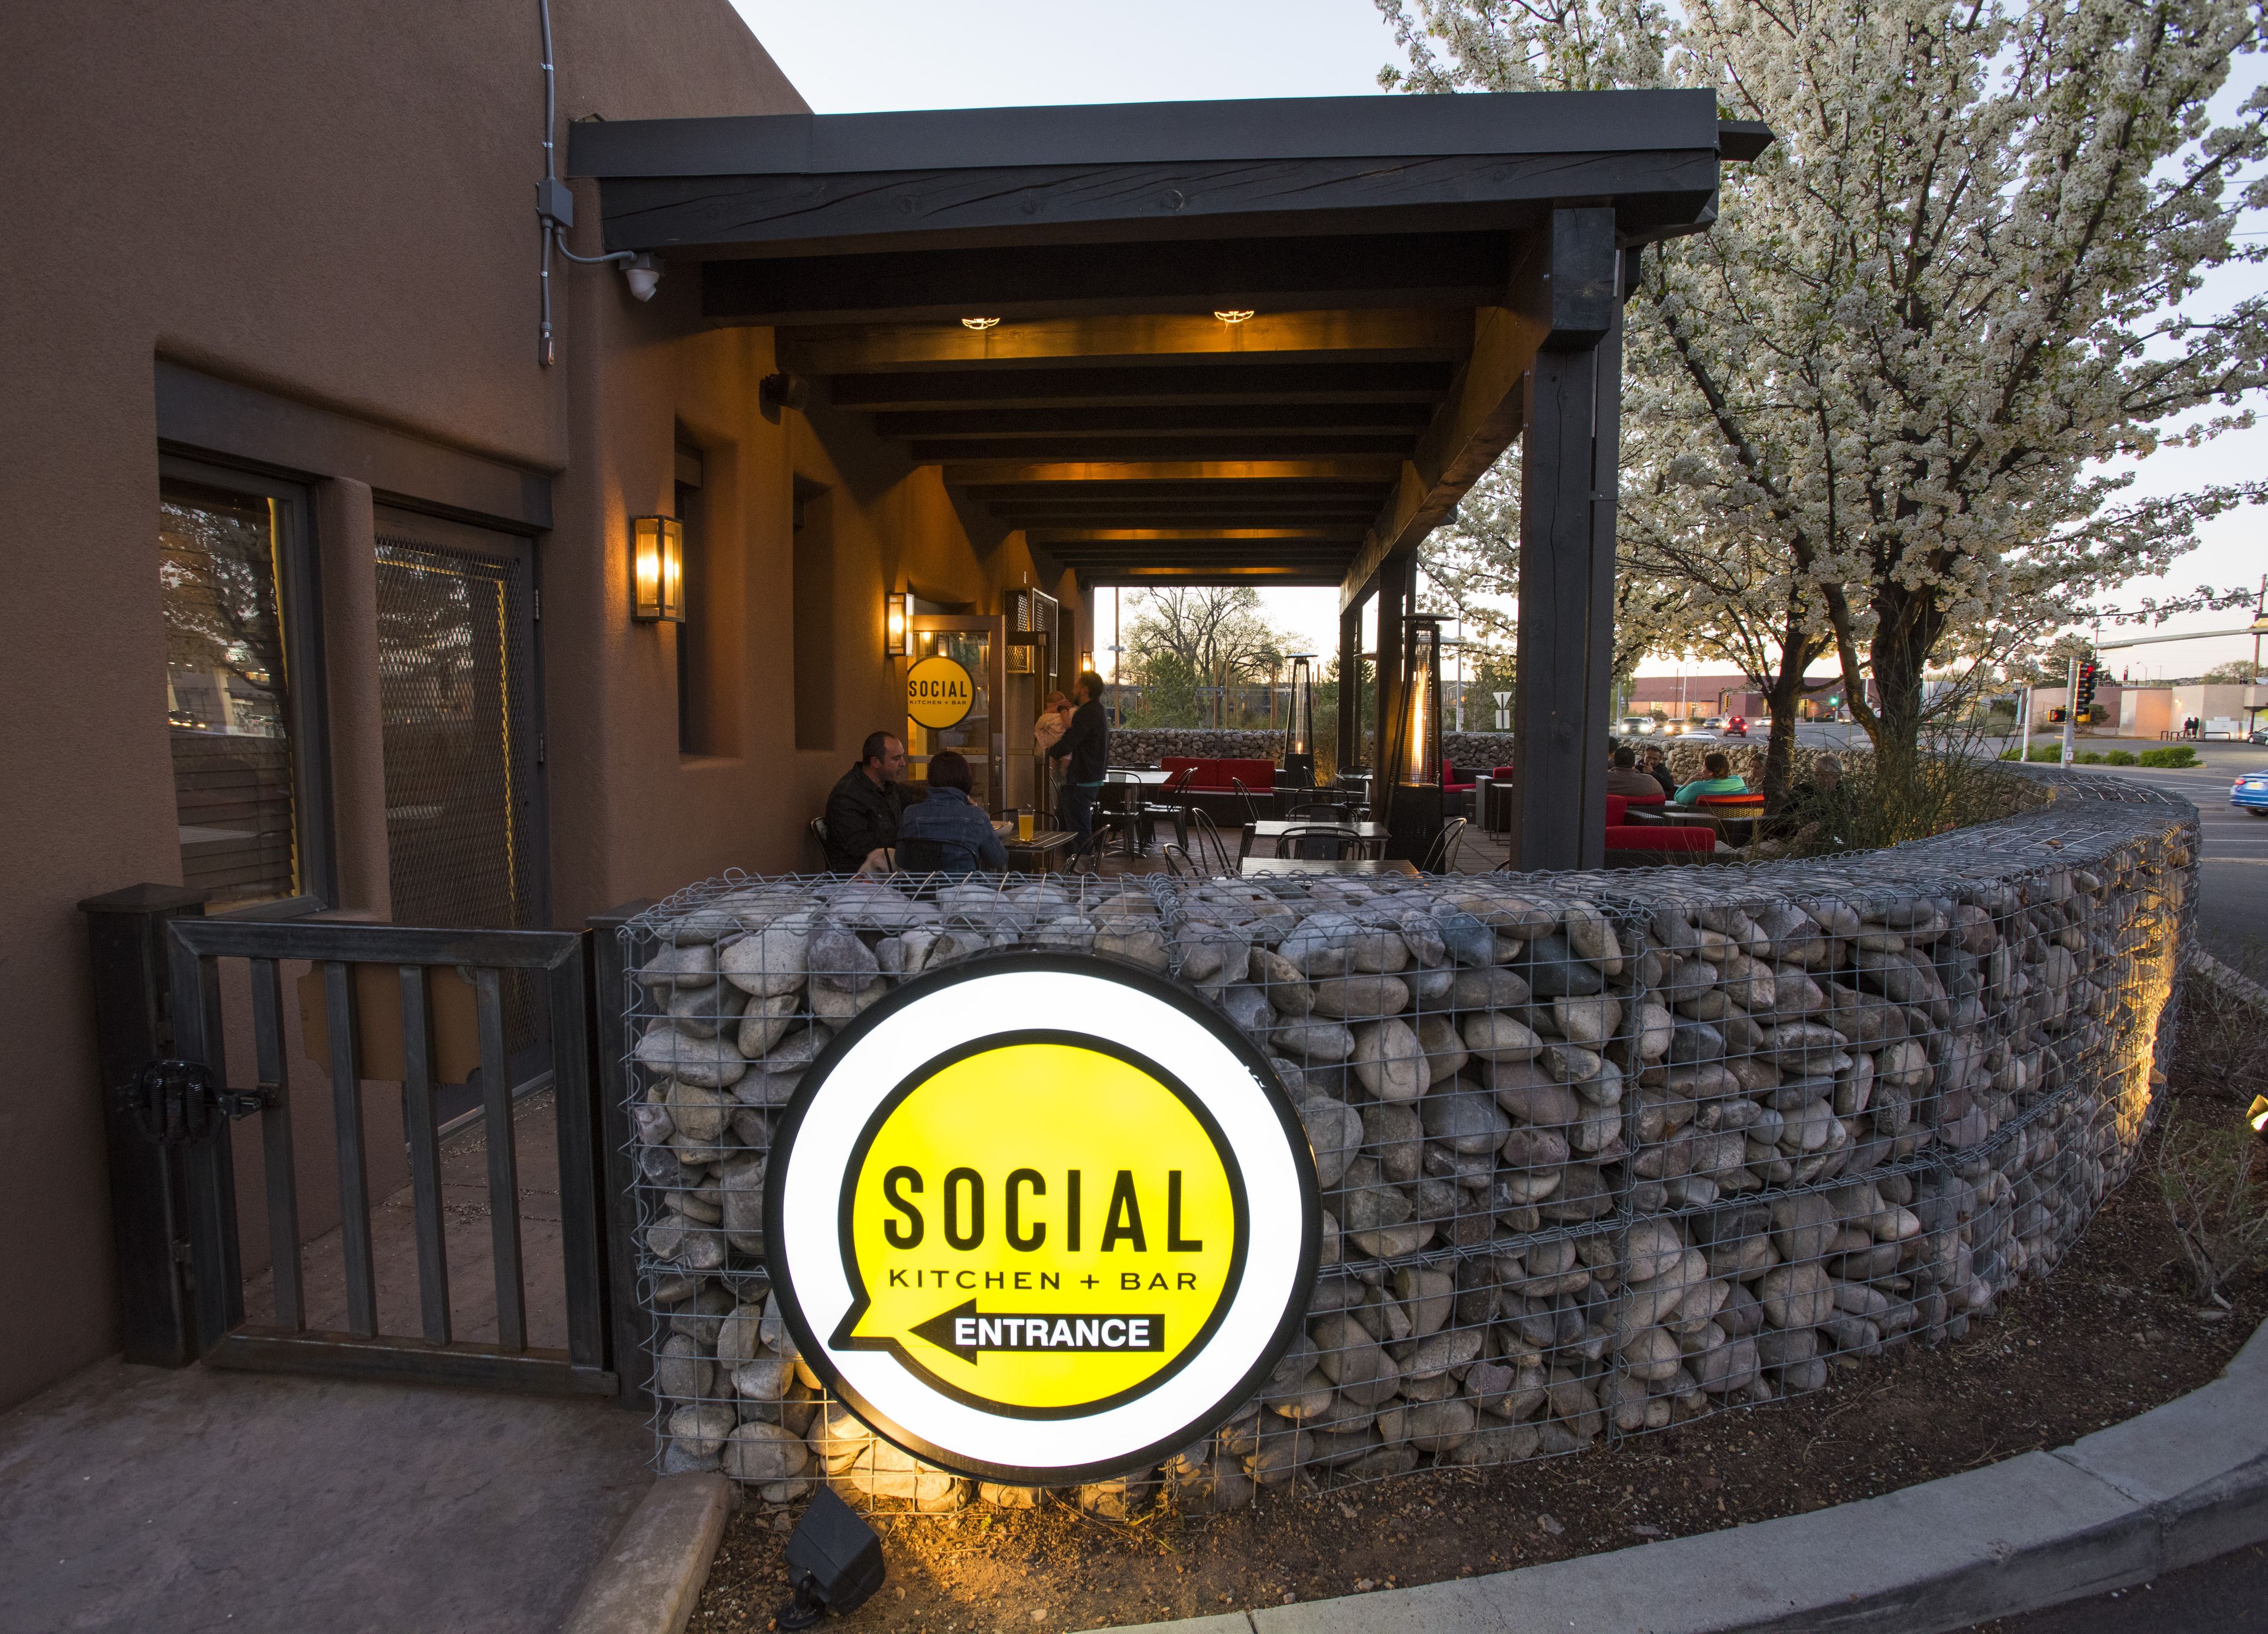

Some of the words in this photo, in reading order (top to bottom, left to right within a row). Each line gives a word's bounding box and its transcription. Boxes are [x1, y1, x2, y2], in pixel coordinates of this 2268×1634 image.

[909, 680, 967, 698] SOCIAL
[883, 1166, 1203, 1252] SOCIAL
[889, 1268, 1060, 1290] KITCHEN
[1080, 1274, 1100, 1290] +
[1120, 1272, 1197, 1291] BAR
[954, 1317, 1151, 1347] ENTRANCE
